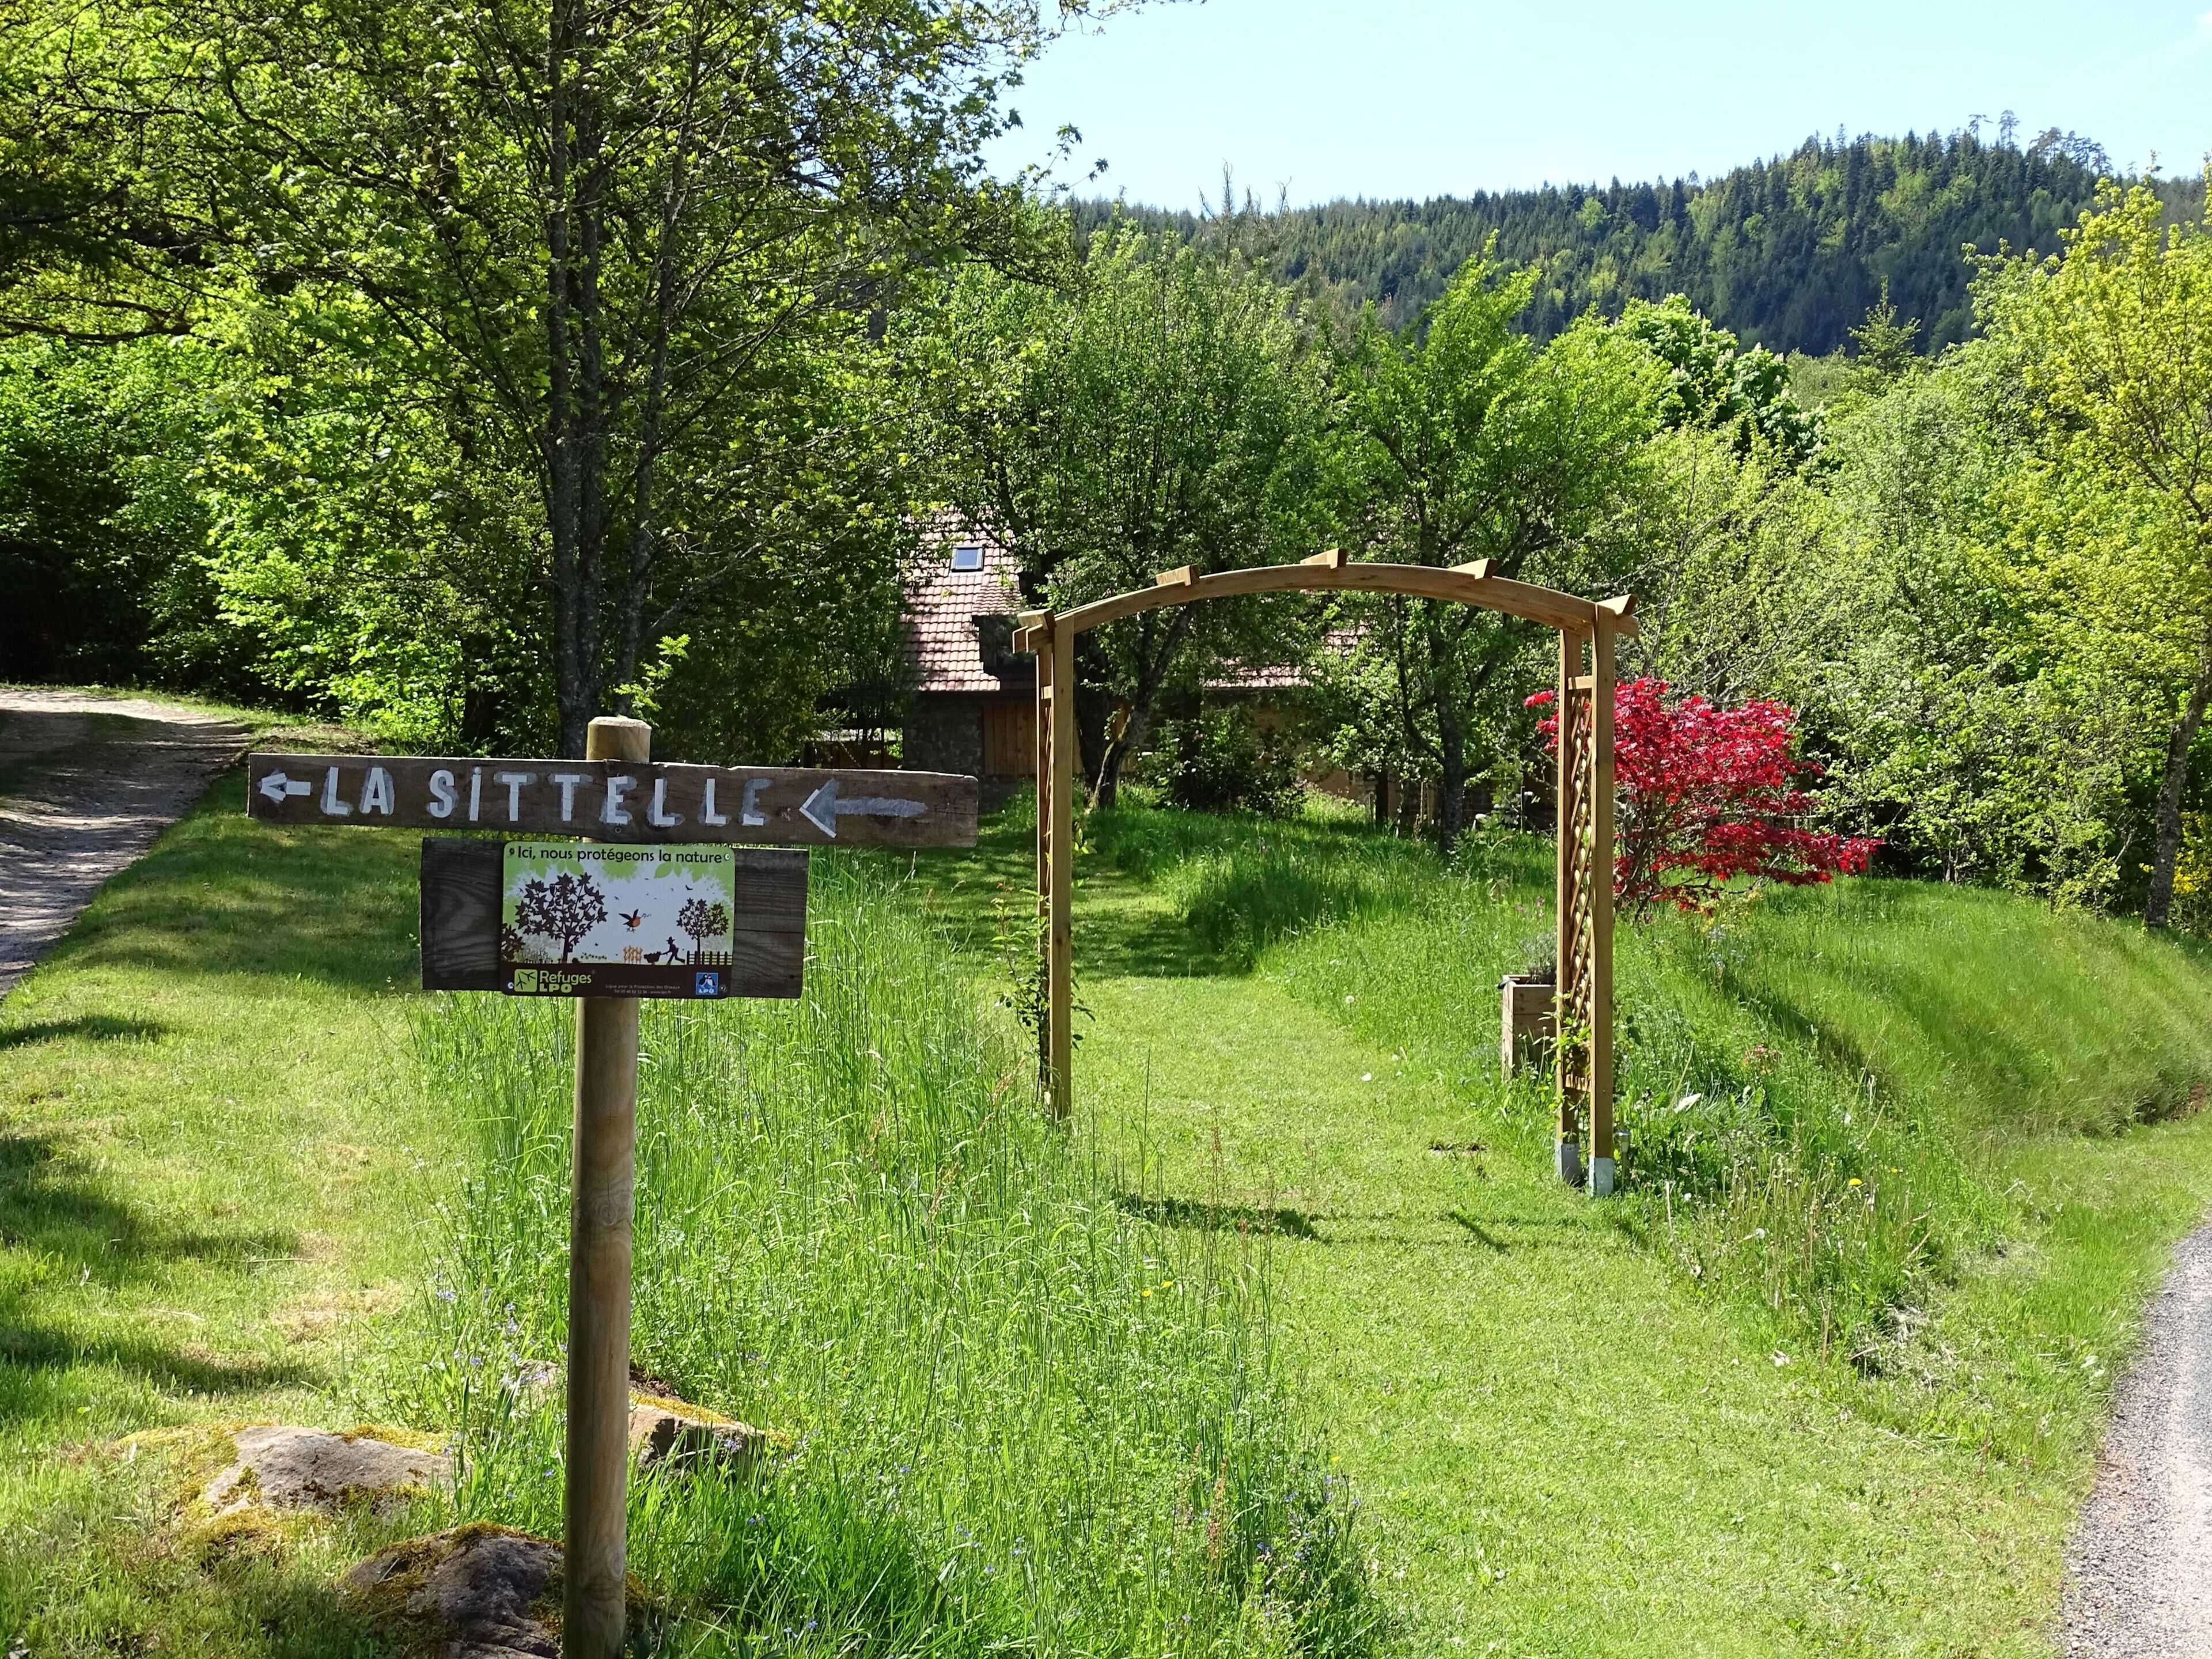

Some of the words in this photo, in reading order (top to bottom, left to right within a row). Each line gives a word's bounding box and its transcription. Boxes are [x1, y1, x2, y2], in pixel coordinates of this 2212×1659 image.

[320, 766, 395, 816] LA
[518, 846, 536, 859] Ici,
[541, 850, 573, 859] nous
[577, 848, 654, 862] protégeons
[659, 850, 671, 862] la
[676, 851, 722, 863] nature
[539, 970, 592, 985] Refuges
[539, 983, 573, 993] LPO
